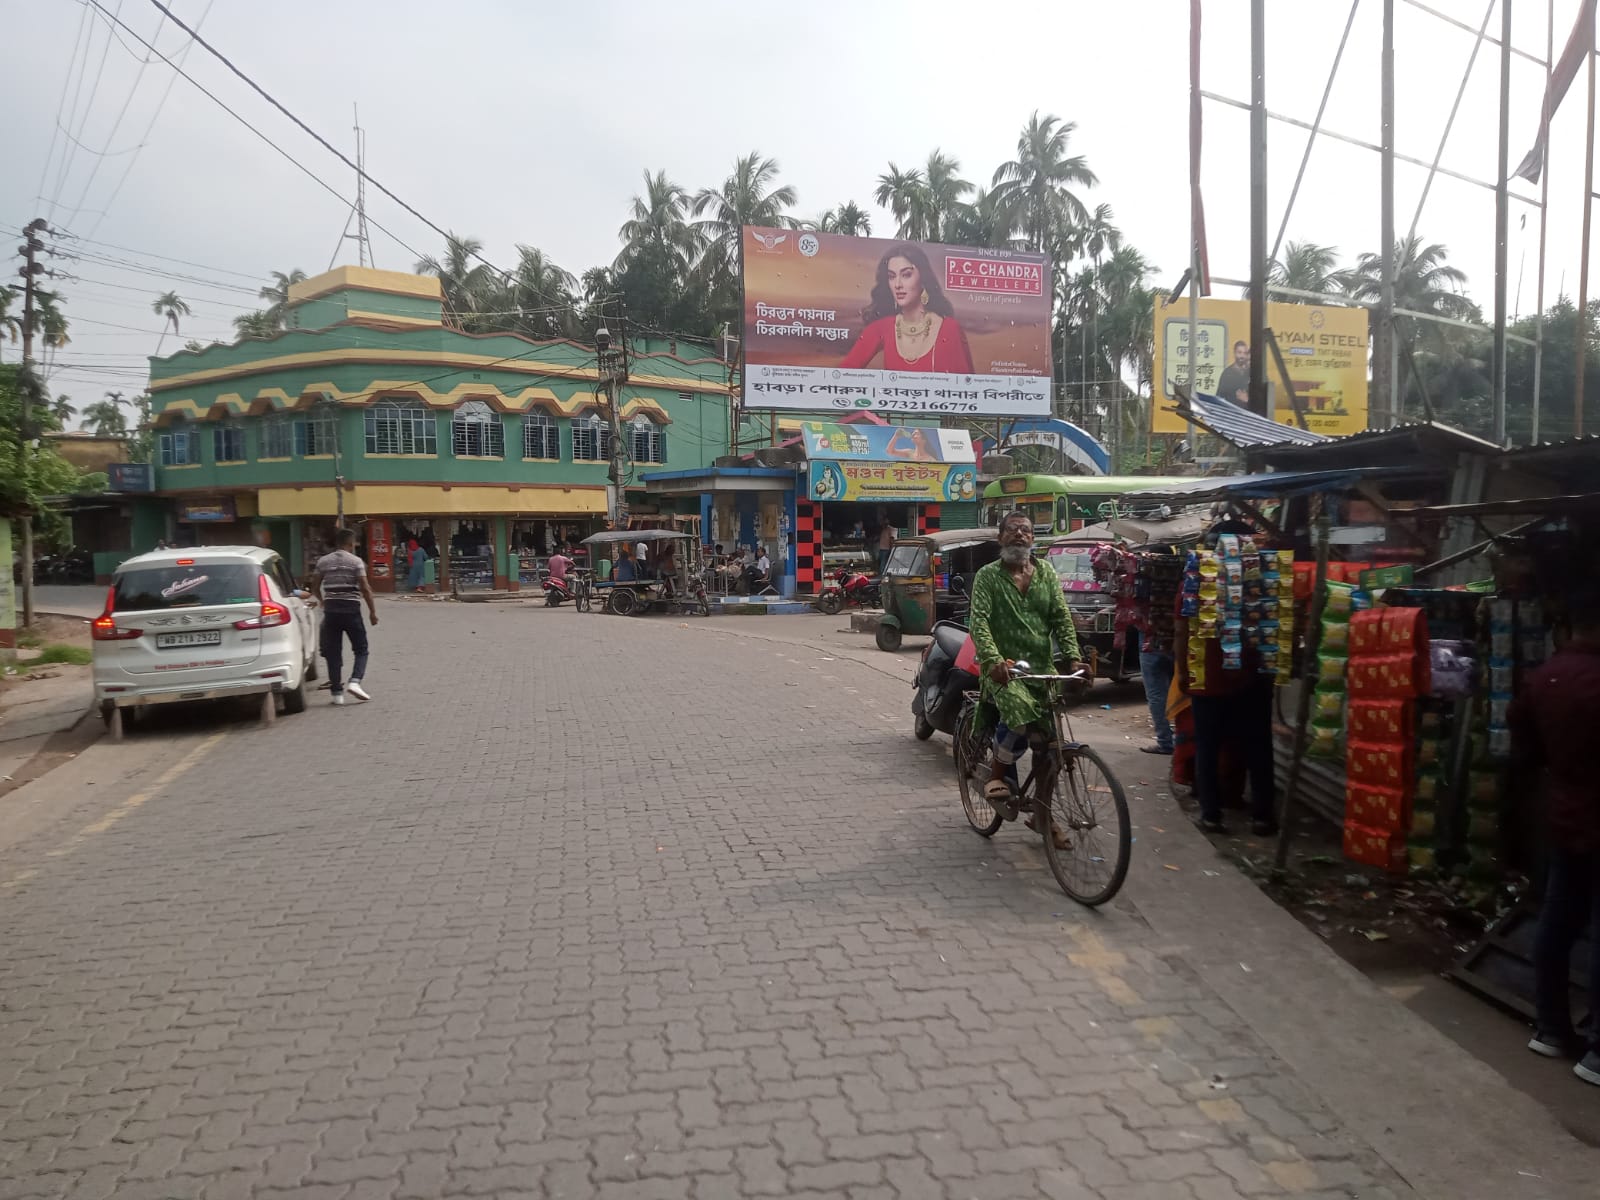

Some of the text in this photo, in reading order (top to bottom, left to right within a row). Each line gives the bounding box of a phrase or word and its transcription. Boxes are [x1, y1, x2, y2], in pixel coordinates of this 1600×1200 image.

[978, 248, 997, 257] SINCE
[949, 260, 1039, 279] P. C. CHANDRA
[949, 276, 1040, 290] JEWELLERS
[755, 302, 836, 321] চিরন্তন গয়নার
[755, 320, 850, 341] চিরকালীন সম্ভার
[1320, 333, 1366, 348] STEEL
[752, 382, 1046, 401] হাবড়া শোরুম হাবড়া থানার বিপরীতে
[878, 399, 978, 411] 9732166776
[846, 466, 887, 480] মণ্ডল
